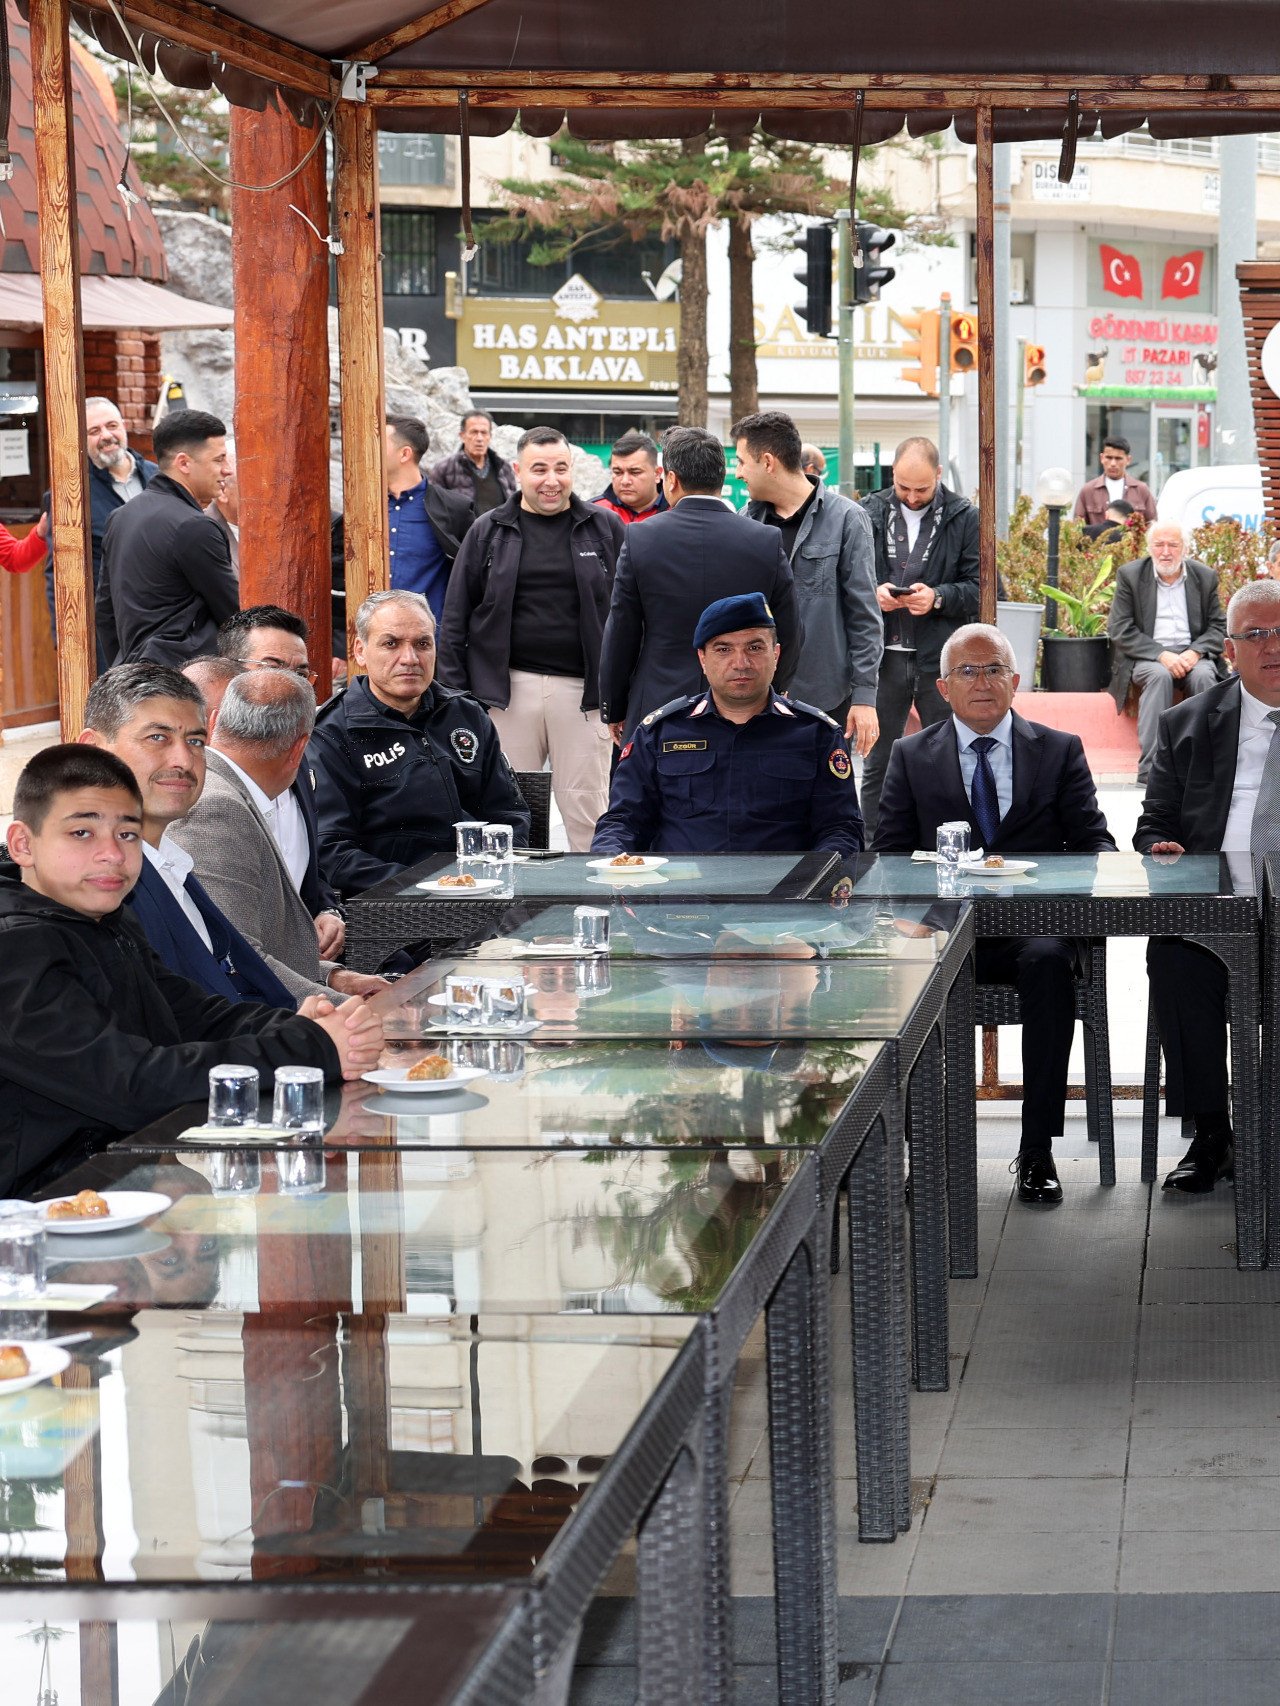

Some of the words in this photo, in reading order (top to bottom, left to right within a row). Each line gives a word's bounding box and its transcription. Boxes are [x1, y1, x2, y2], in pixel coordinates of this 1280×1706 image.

[473, 324, 537, 349] HAS
[1171, 322, 1218, 345] KASA
[777, 345, 888, 358] KUYUMCLUK
[1142, 348, 1190, 365] PAZARI
[499, 354, 644, 382] BAKLAVA
